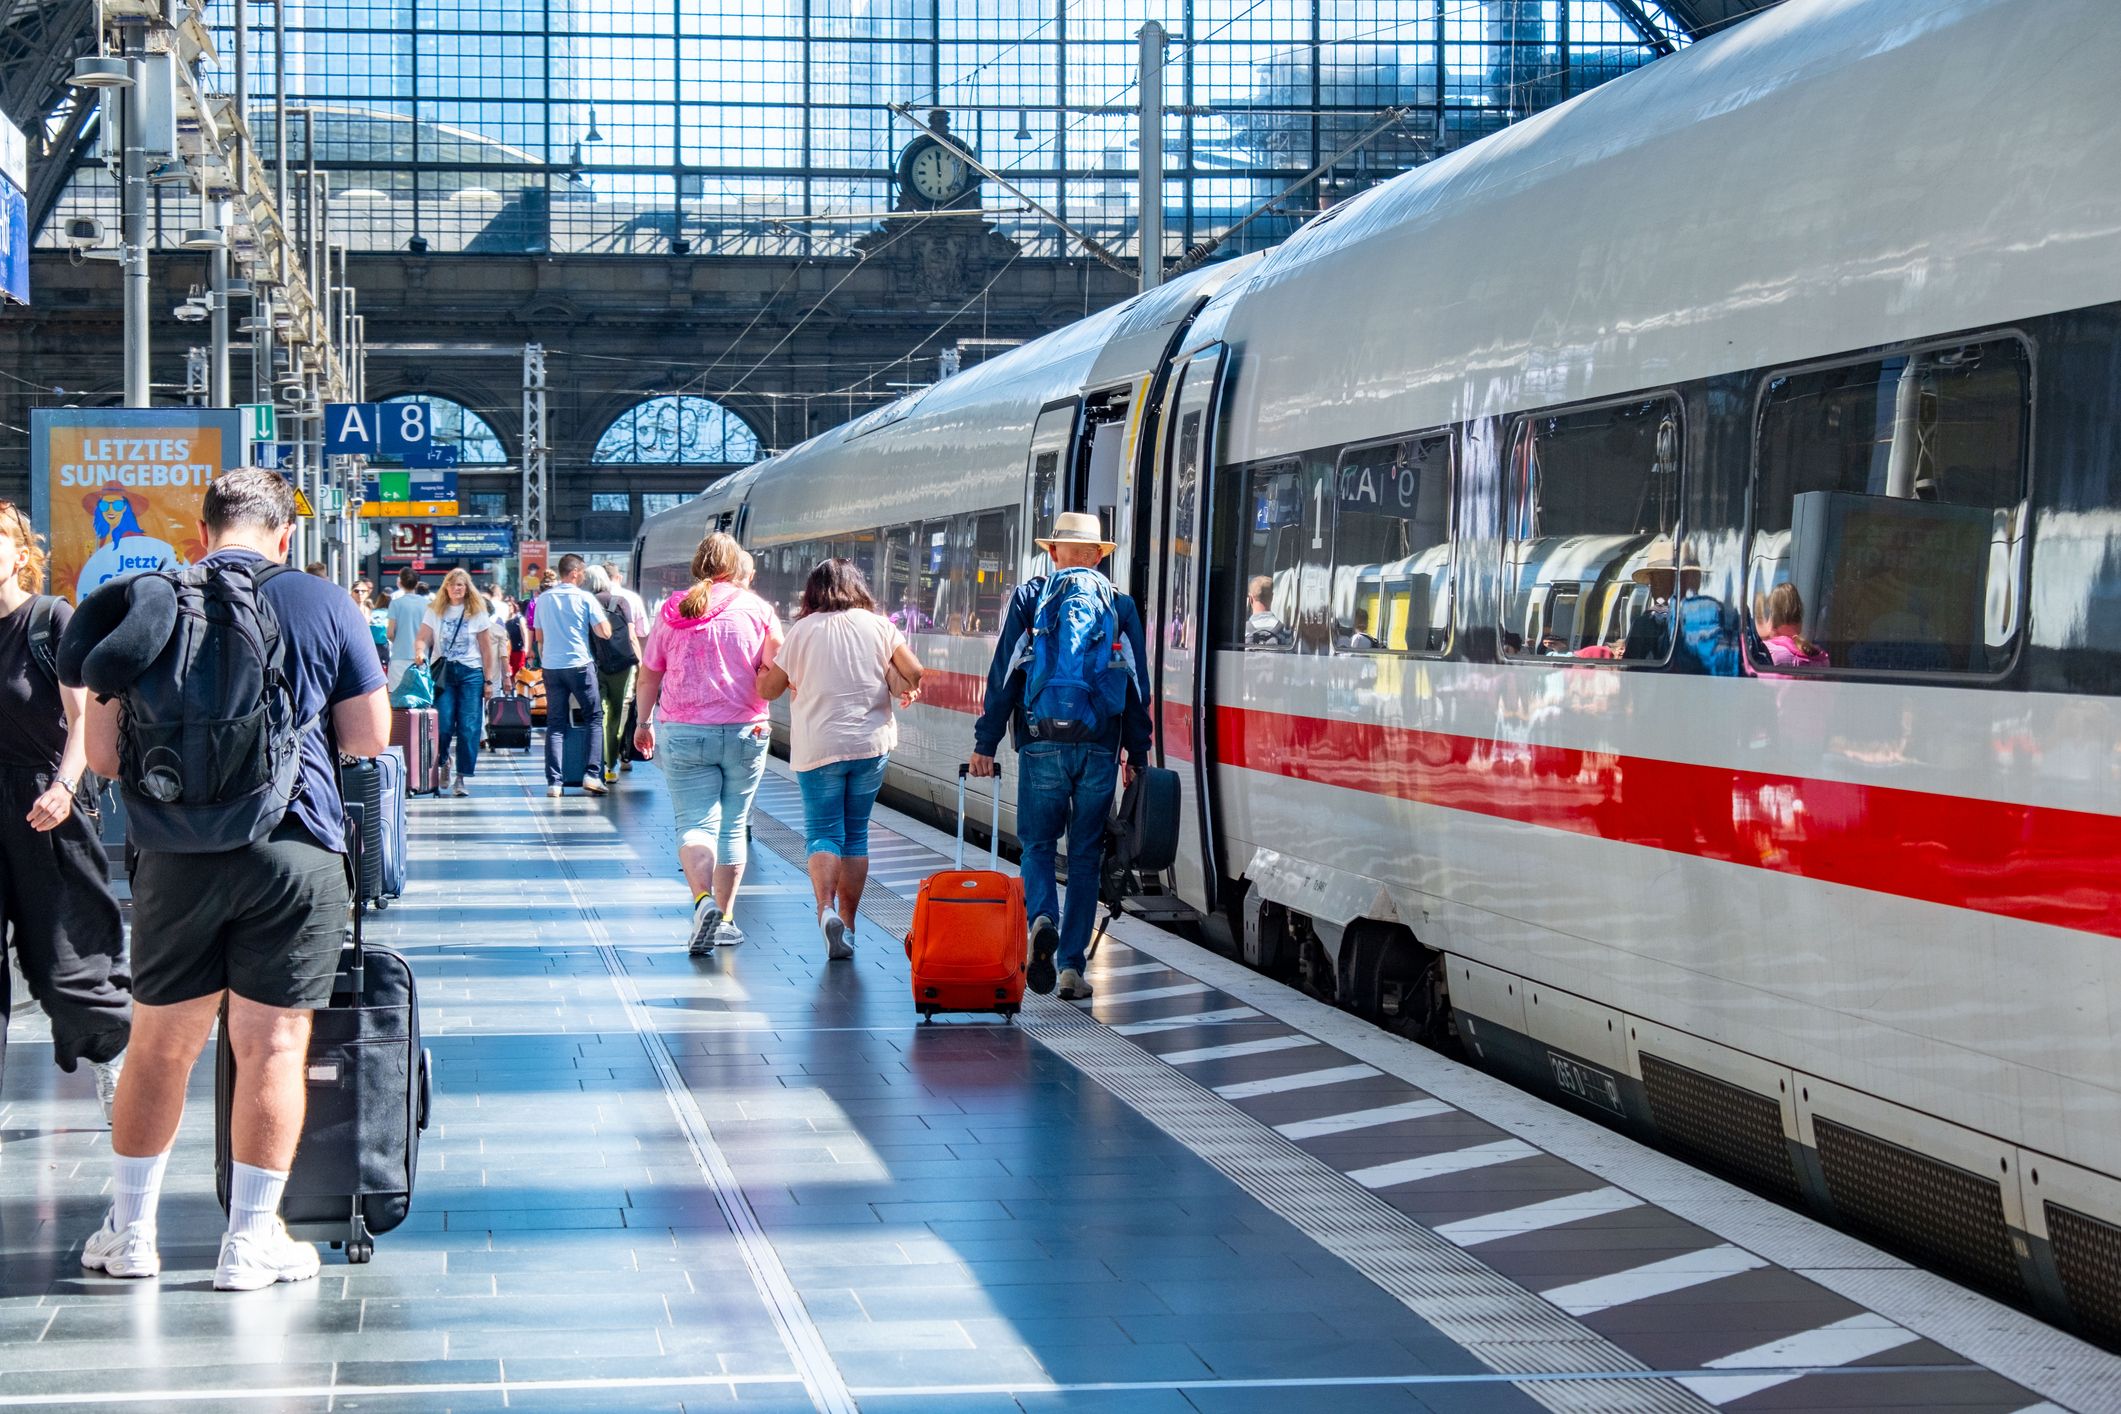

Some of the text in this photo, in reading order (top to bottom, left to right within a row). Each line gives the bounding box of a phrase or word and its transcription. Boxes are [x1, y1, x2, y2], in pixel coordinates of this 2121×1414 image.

[338, 404, 425, 442] A 8
[83, 439, 190, 461] LETZTES
[60, 464, 213, 487] SUNGEBOT!
[1312, 478, 1323, 549] 1
[117, 555, 158, 572] Jetzt
